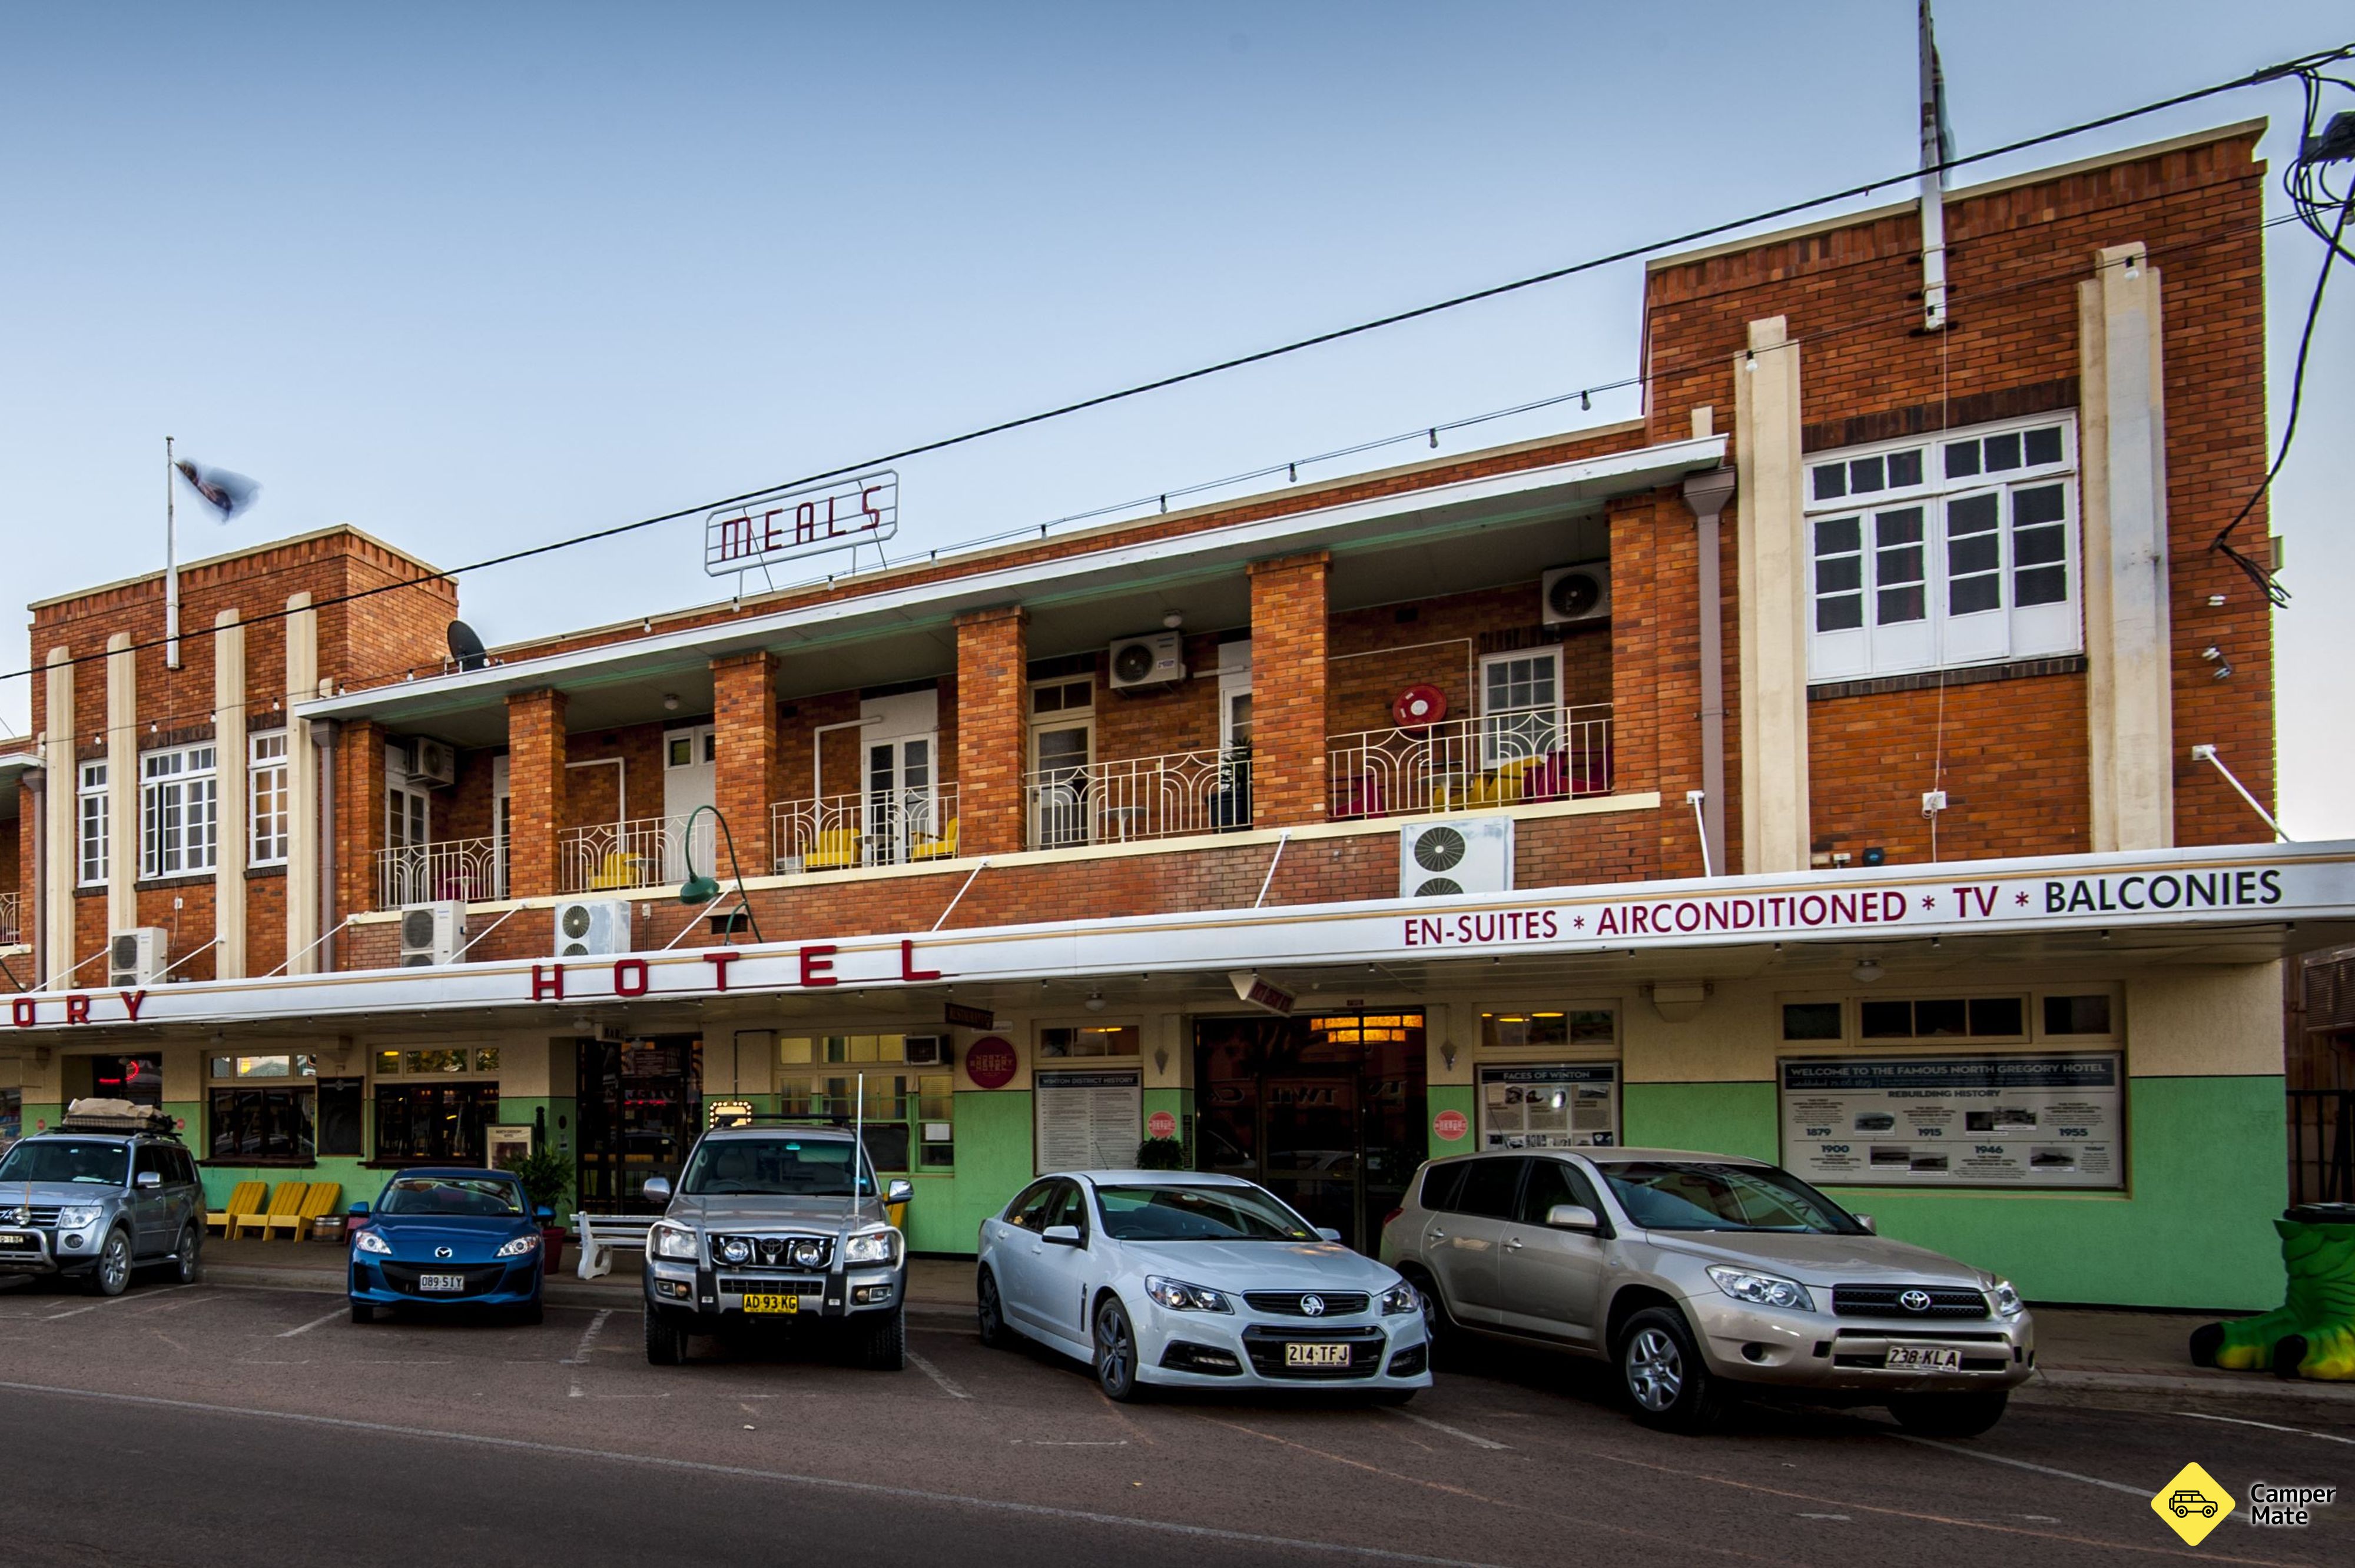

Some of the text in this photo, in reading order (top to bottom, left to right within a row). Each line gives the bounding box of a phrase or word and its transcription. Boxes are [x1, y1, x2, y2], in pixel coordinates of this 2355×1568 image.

[721, 485, 882, 561] MEALS
[1405, 869, 2282, 945] EN-SUITES AIRCONDITIONED TV BALCONIES
[531, 939, 941, 1001] HOTEL
[604, 1027, 621, 1039] BAR
[1791, 1063, 2106, 1077] WELCOME TO THE FAMOUS NORTH GREGORY HOTEL
[1502, 1071, 1590, 1080] FACES OF WINTON
[1806, 1128, 1832, 1137] 1879
[1917, 1128, 1942, 1137] 1915
[2058, 1128, 2088, 1137] 1955
[1821, 1144, 1850, 1154] 1900
[1975, 1145, 2004, 1154] 1946
